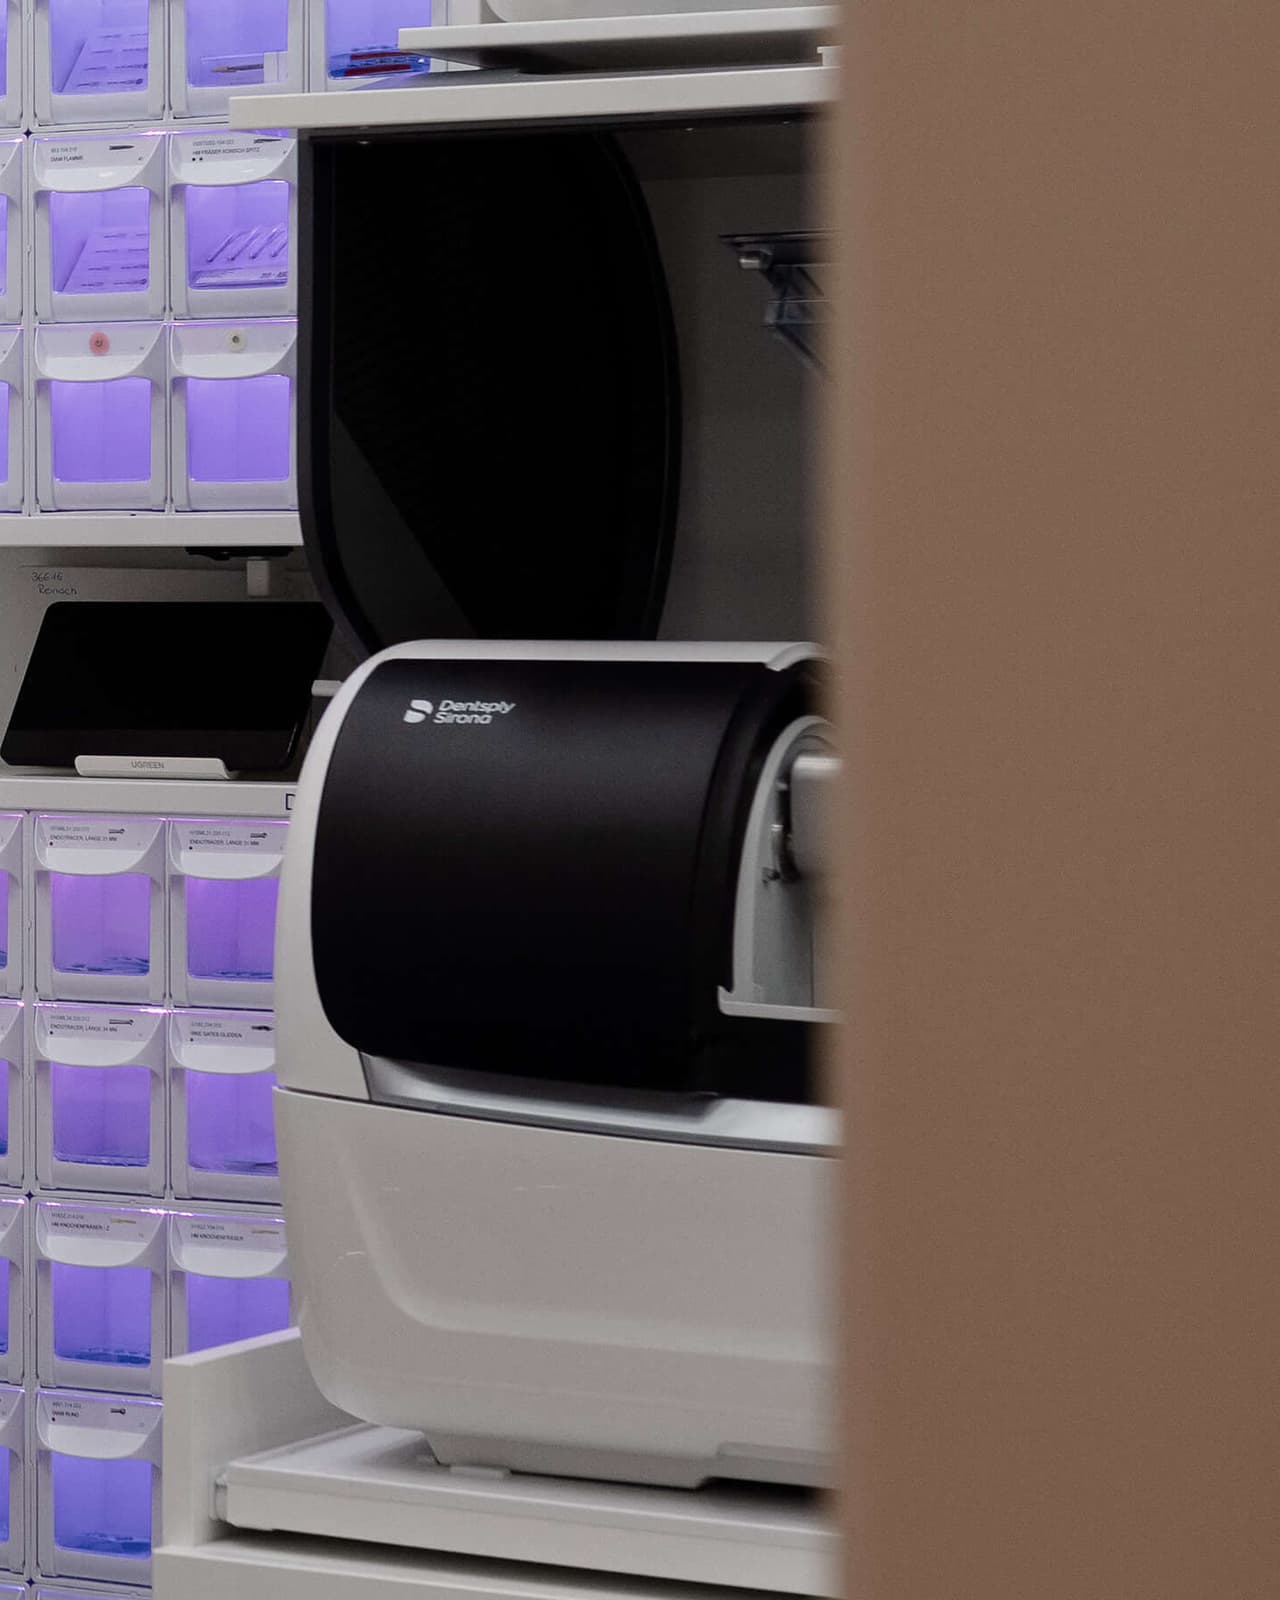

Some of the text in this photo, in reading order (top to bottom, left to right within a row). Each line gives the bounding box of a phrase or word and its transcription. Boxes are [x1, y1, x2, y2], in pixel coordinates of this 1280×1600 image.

[439, 700, 516, 714] Dentsply
[433, 712, 493, 724] Sirona
[131, 761, 165, 769] UGREEN
